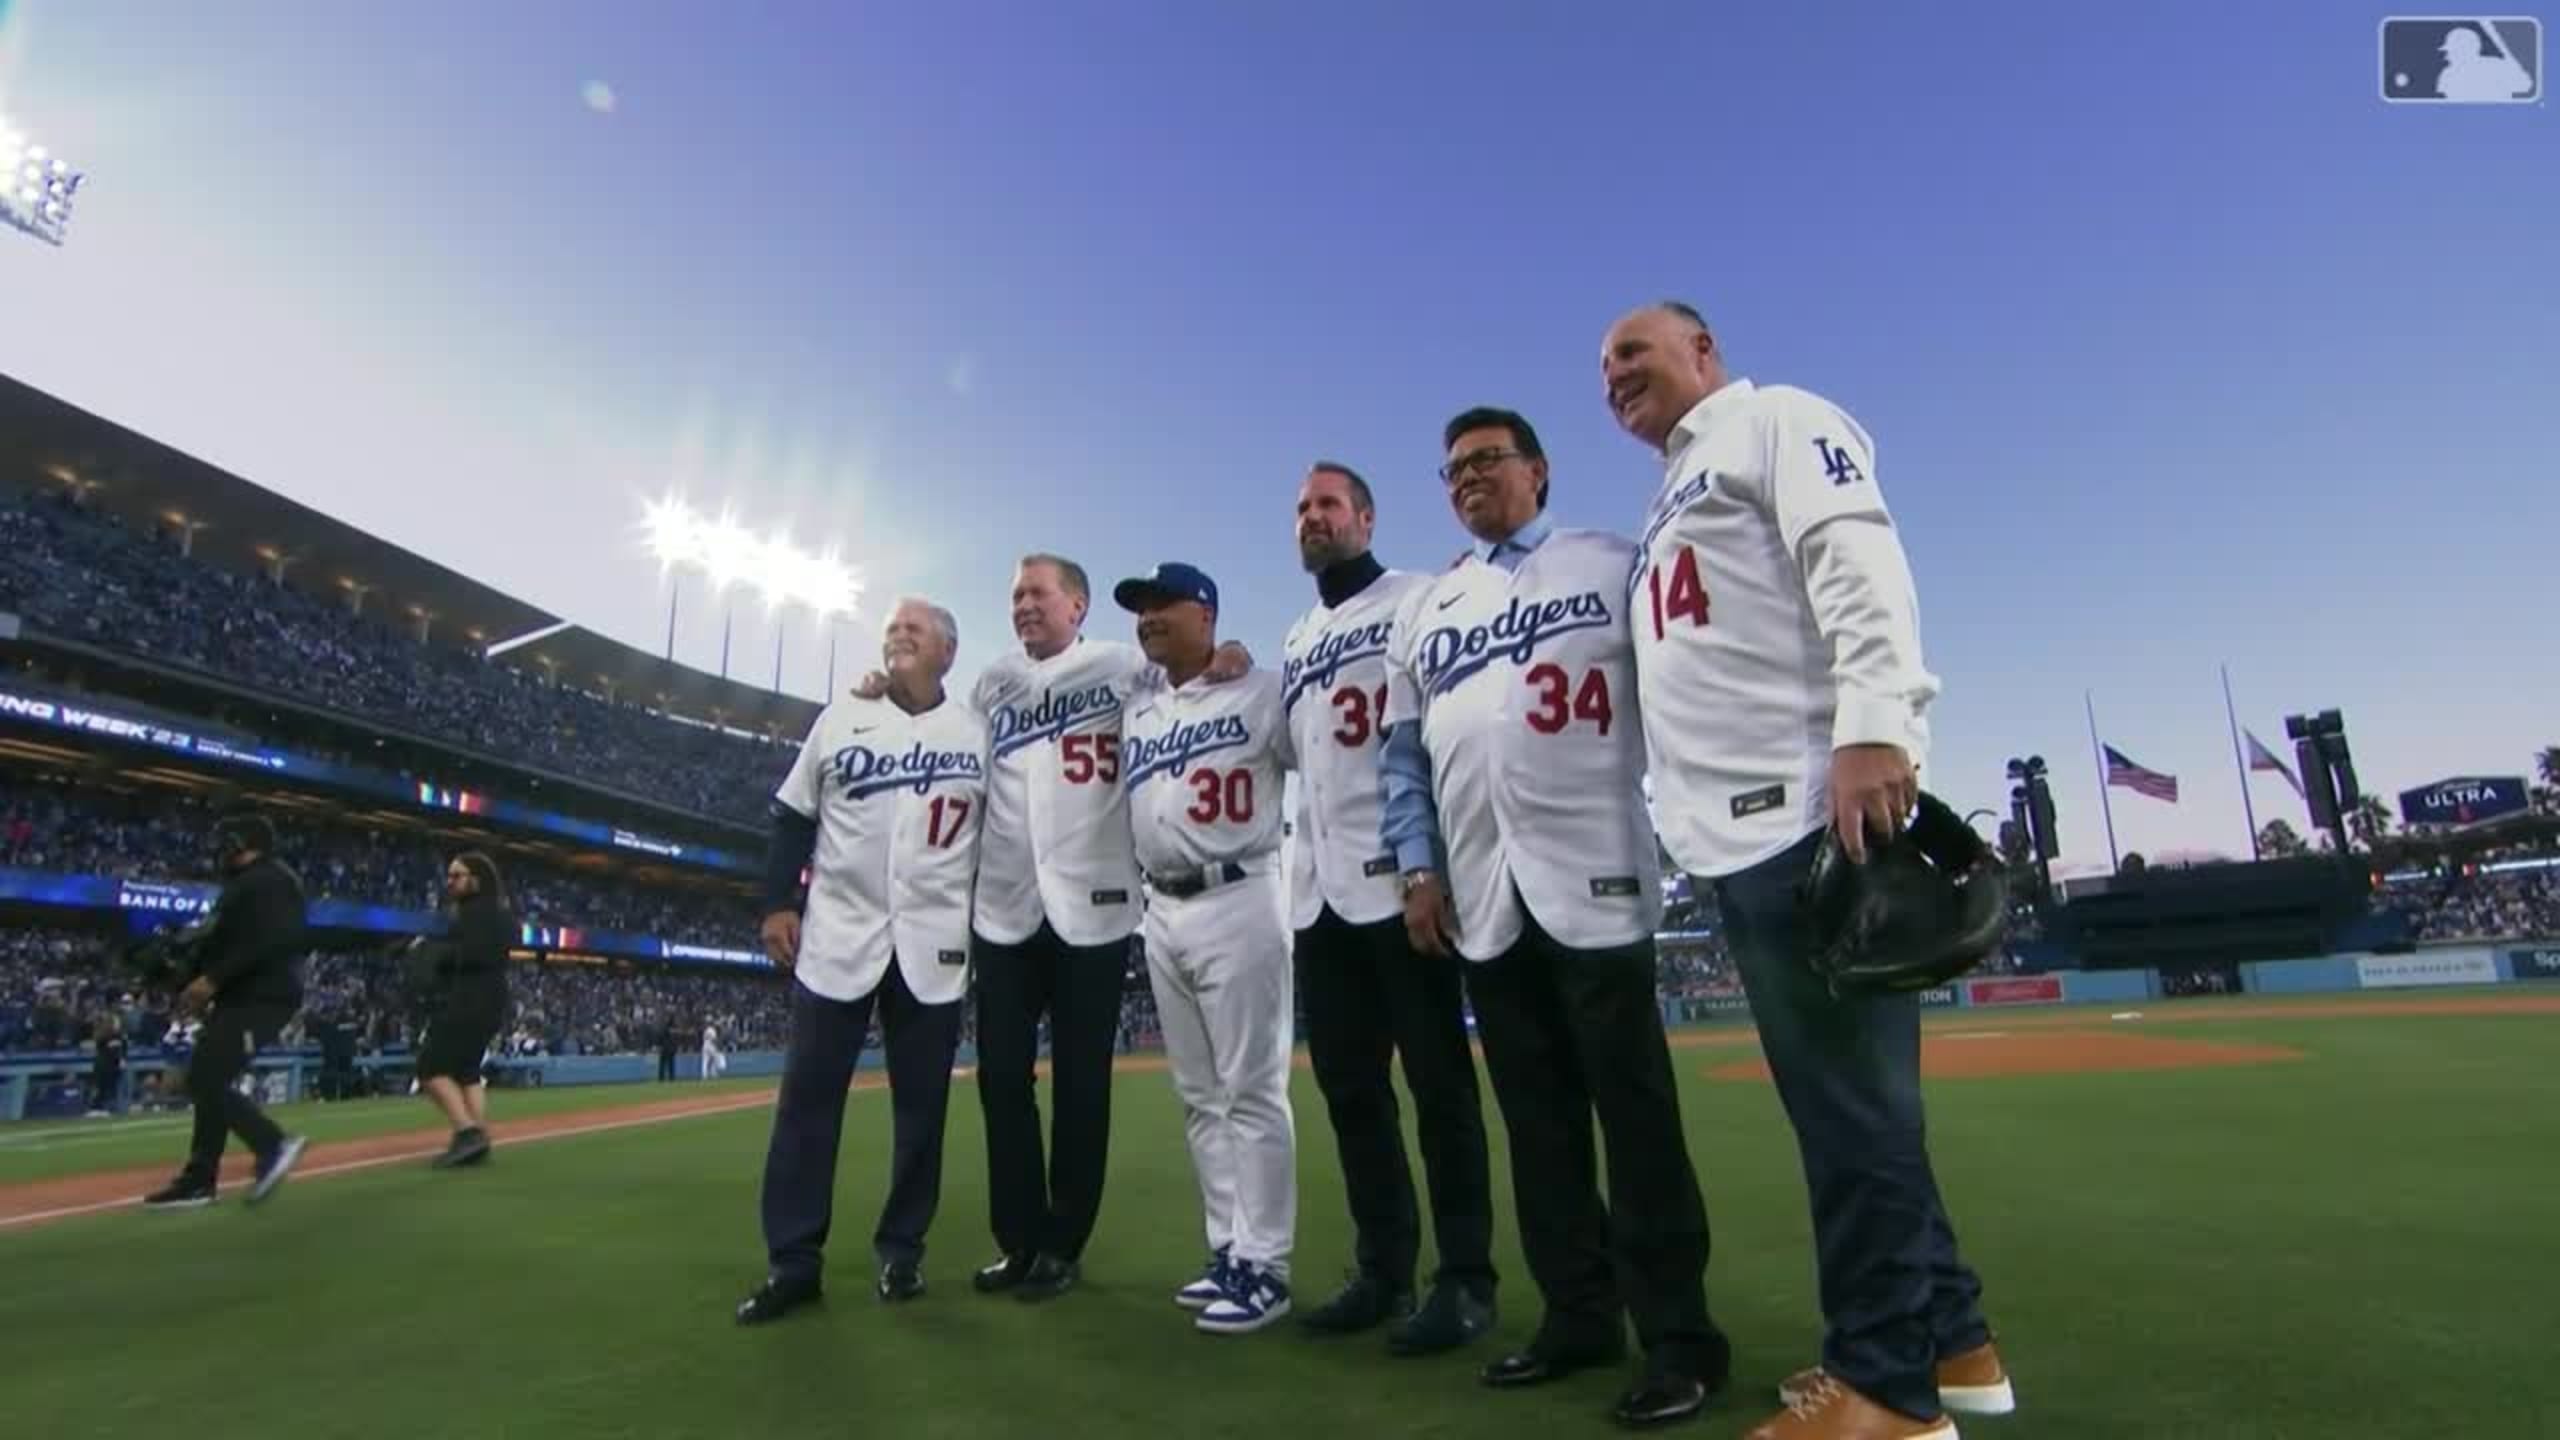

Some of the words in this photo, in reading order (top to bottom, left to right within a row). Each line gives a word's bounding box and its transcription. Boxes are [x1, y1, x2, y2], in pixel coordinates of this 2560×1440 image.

[1812, 437, 1864, 485] LA
[1649, 545, 1711, 641] 14
[1420, 591, 1612, 696] Dodgers
[992, 684, 1121, 760] Dodgers
[1525, 663, 1612, 736] 34
[835, 741, 982, 801] Dodgers
[1062, 733, 1119, 785] 55
[1126, 715, 1250, 791] Dodgers
[928, 795, 971, 849] 17
[1187, 767, 1253, 825] 30
[2424, 786, 2498, 808] ULTRA
[119, 892, 170, 911] BANK
[174, 897, 197, 913] OF
